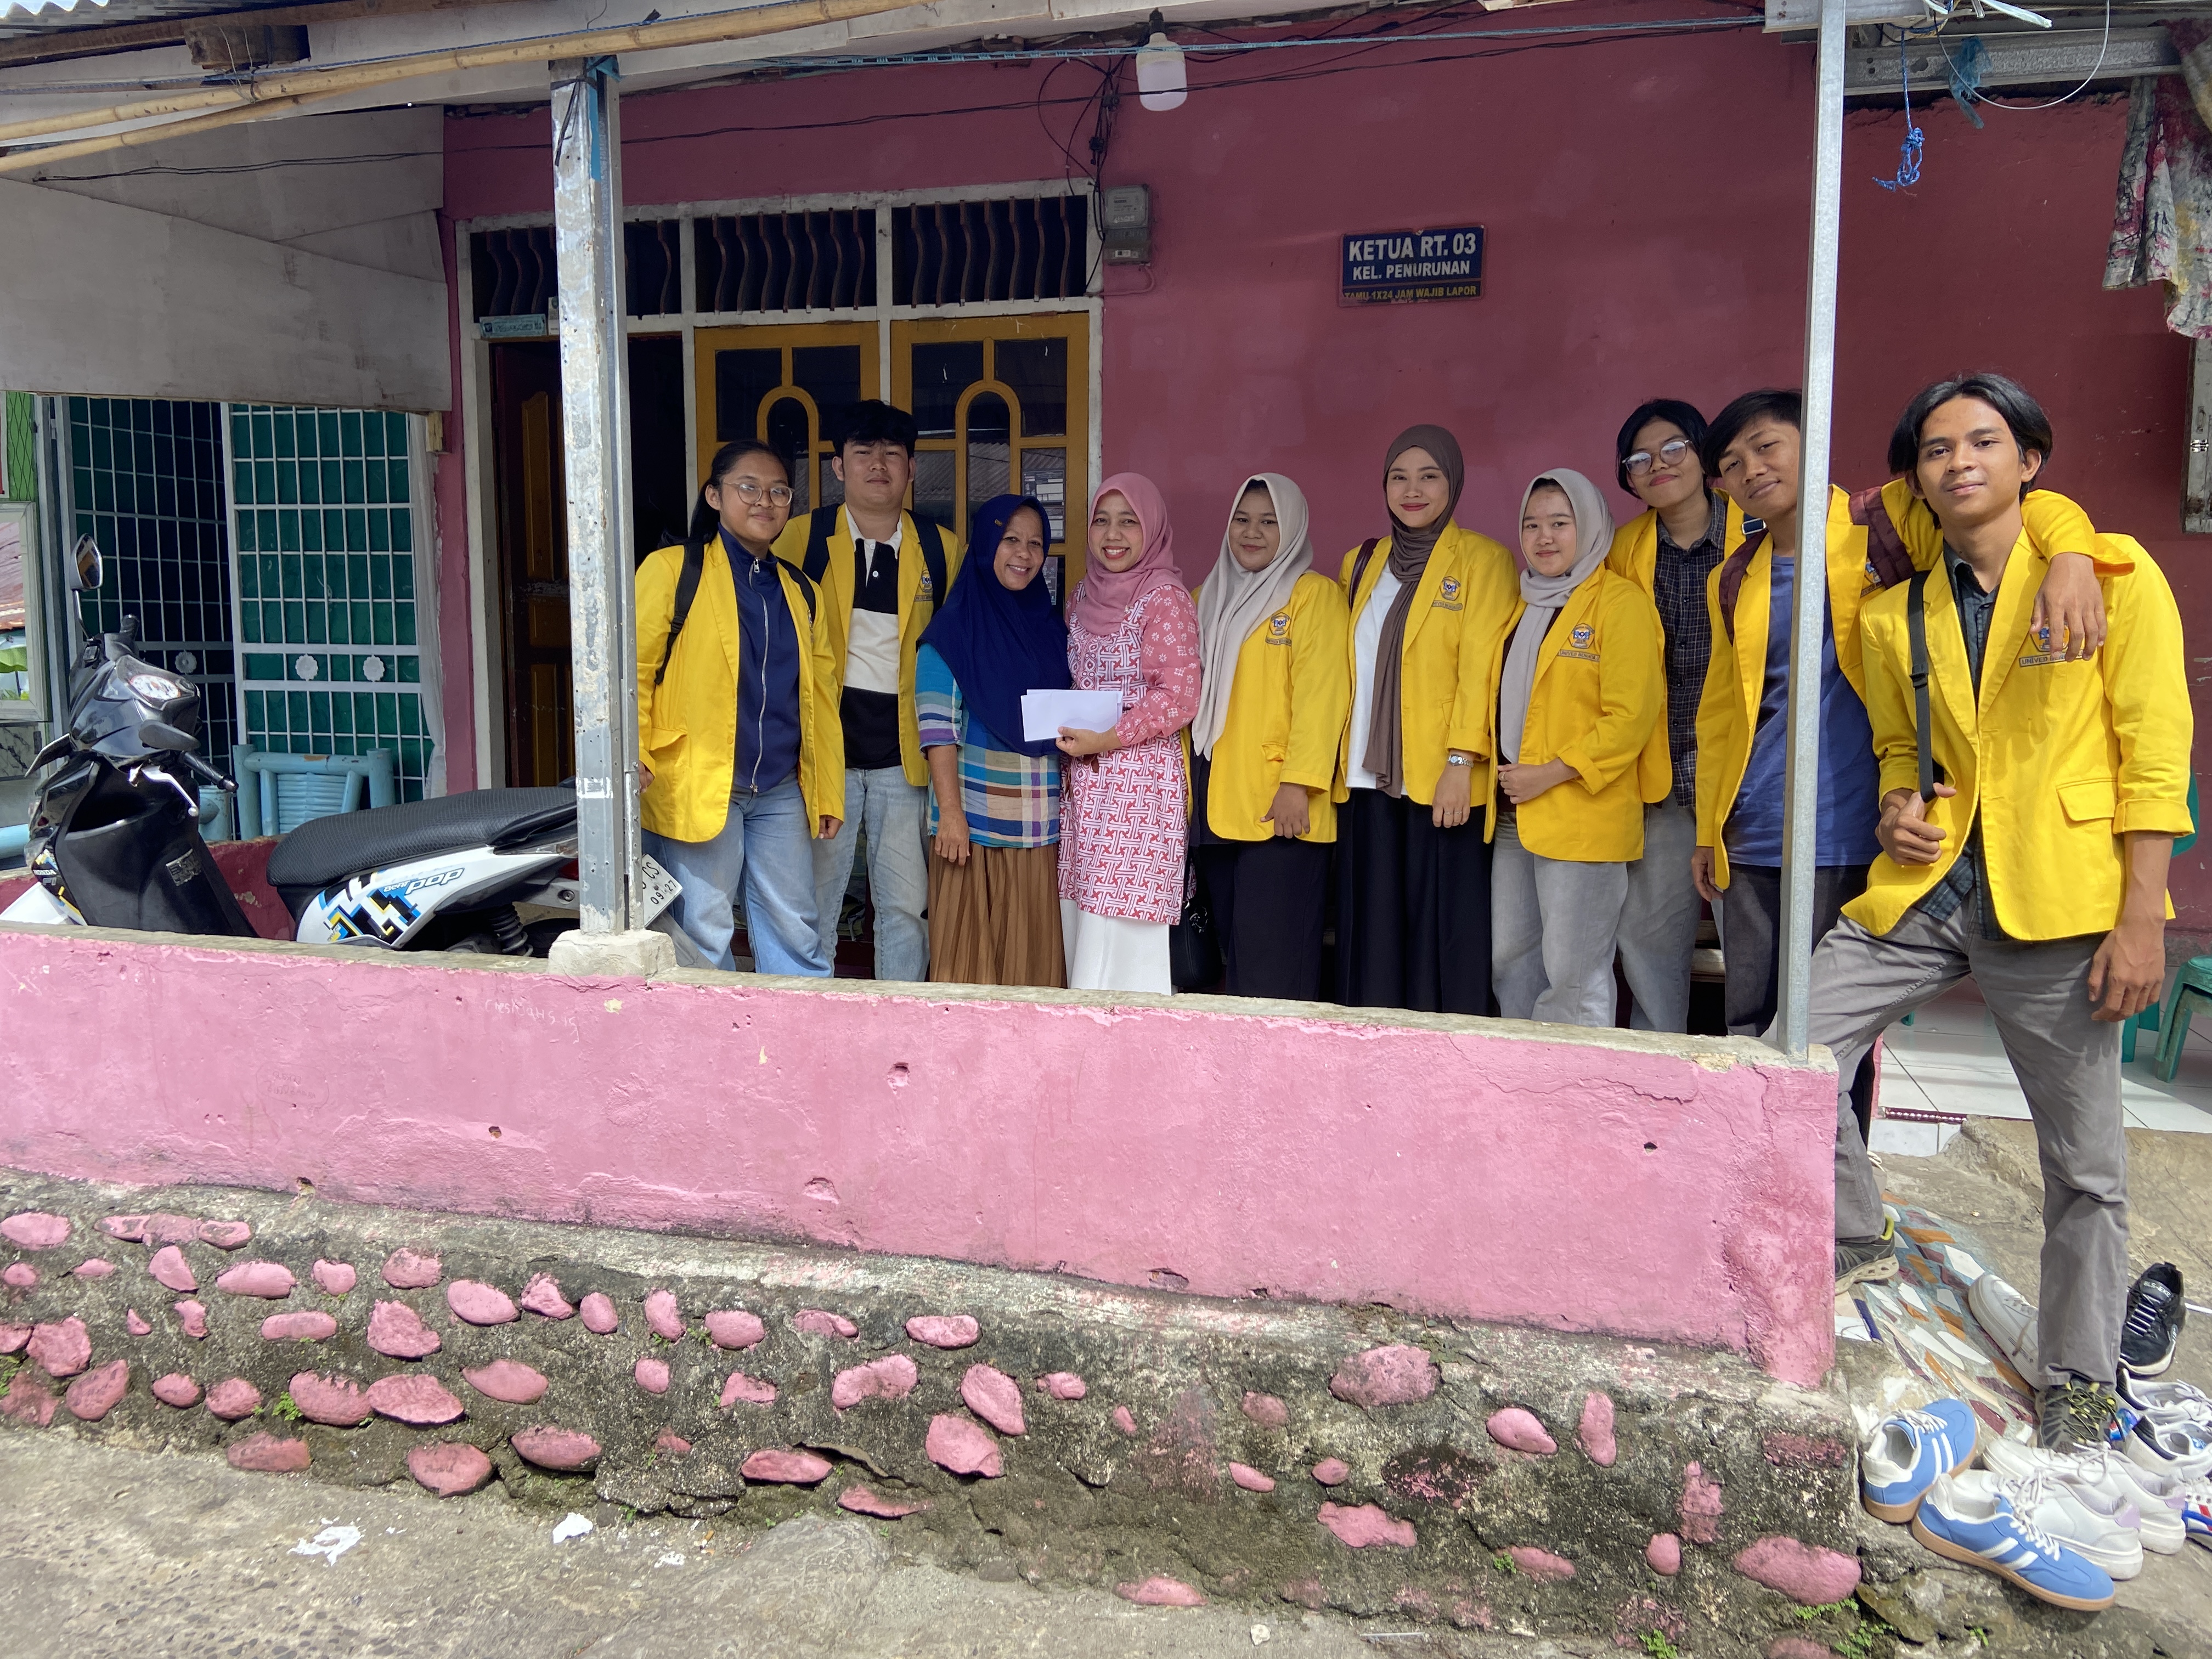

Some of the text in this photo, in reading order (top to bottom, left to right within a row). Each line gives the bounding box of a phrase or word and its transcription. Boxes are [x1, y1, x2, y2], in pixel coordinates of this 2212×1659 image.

[1348, 233, 1476, 262] KETUA RT. 03
[1352, 260, 1470, 280] KEL. PENURUNAN
[1372, 290, 1393, 300] 1X24
[1395, 289, 1414, 299] JAM
[1415, 287, 1444, 297] WAJIB
[1446, 286, 1477, 296] LAPOR
[2022, 656, 2048, 665] UNIVED
[404, 867, 465, 895] pop
